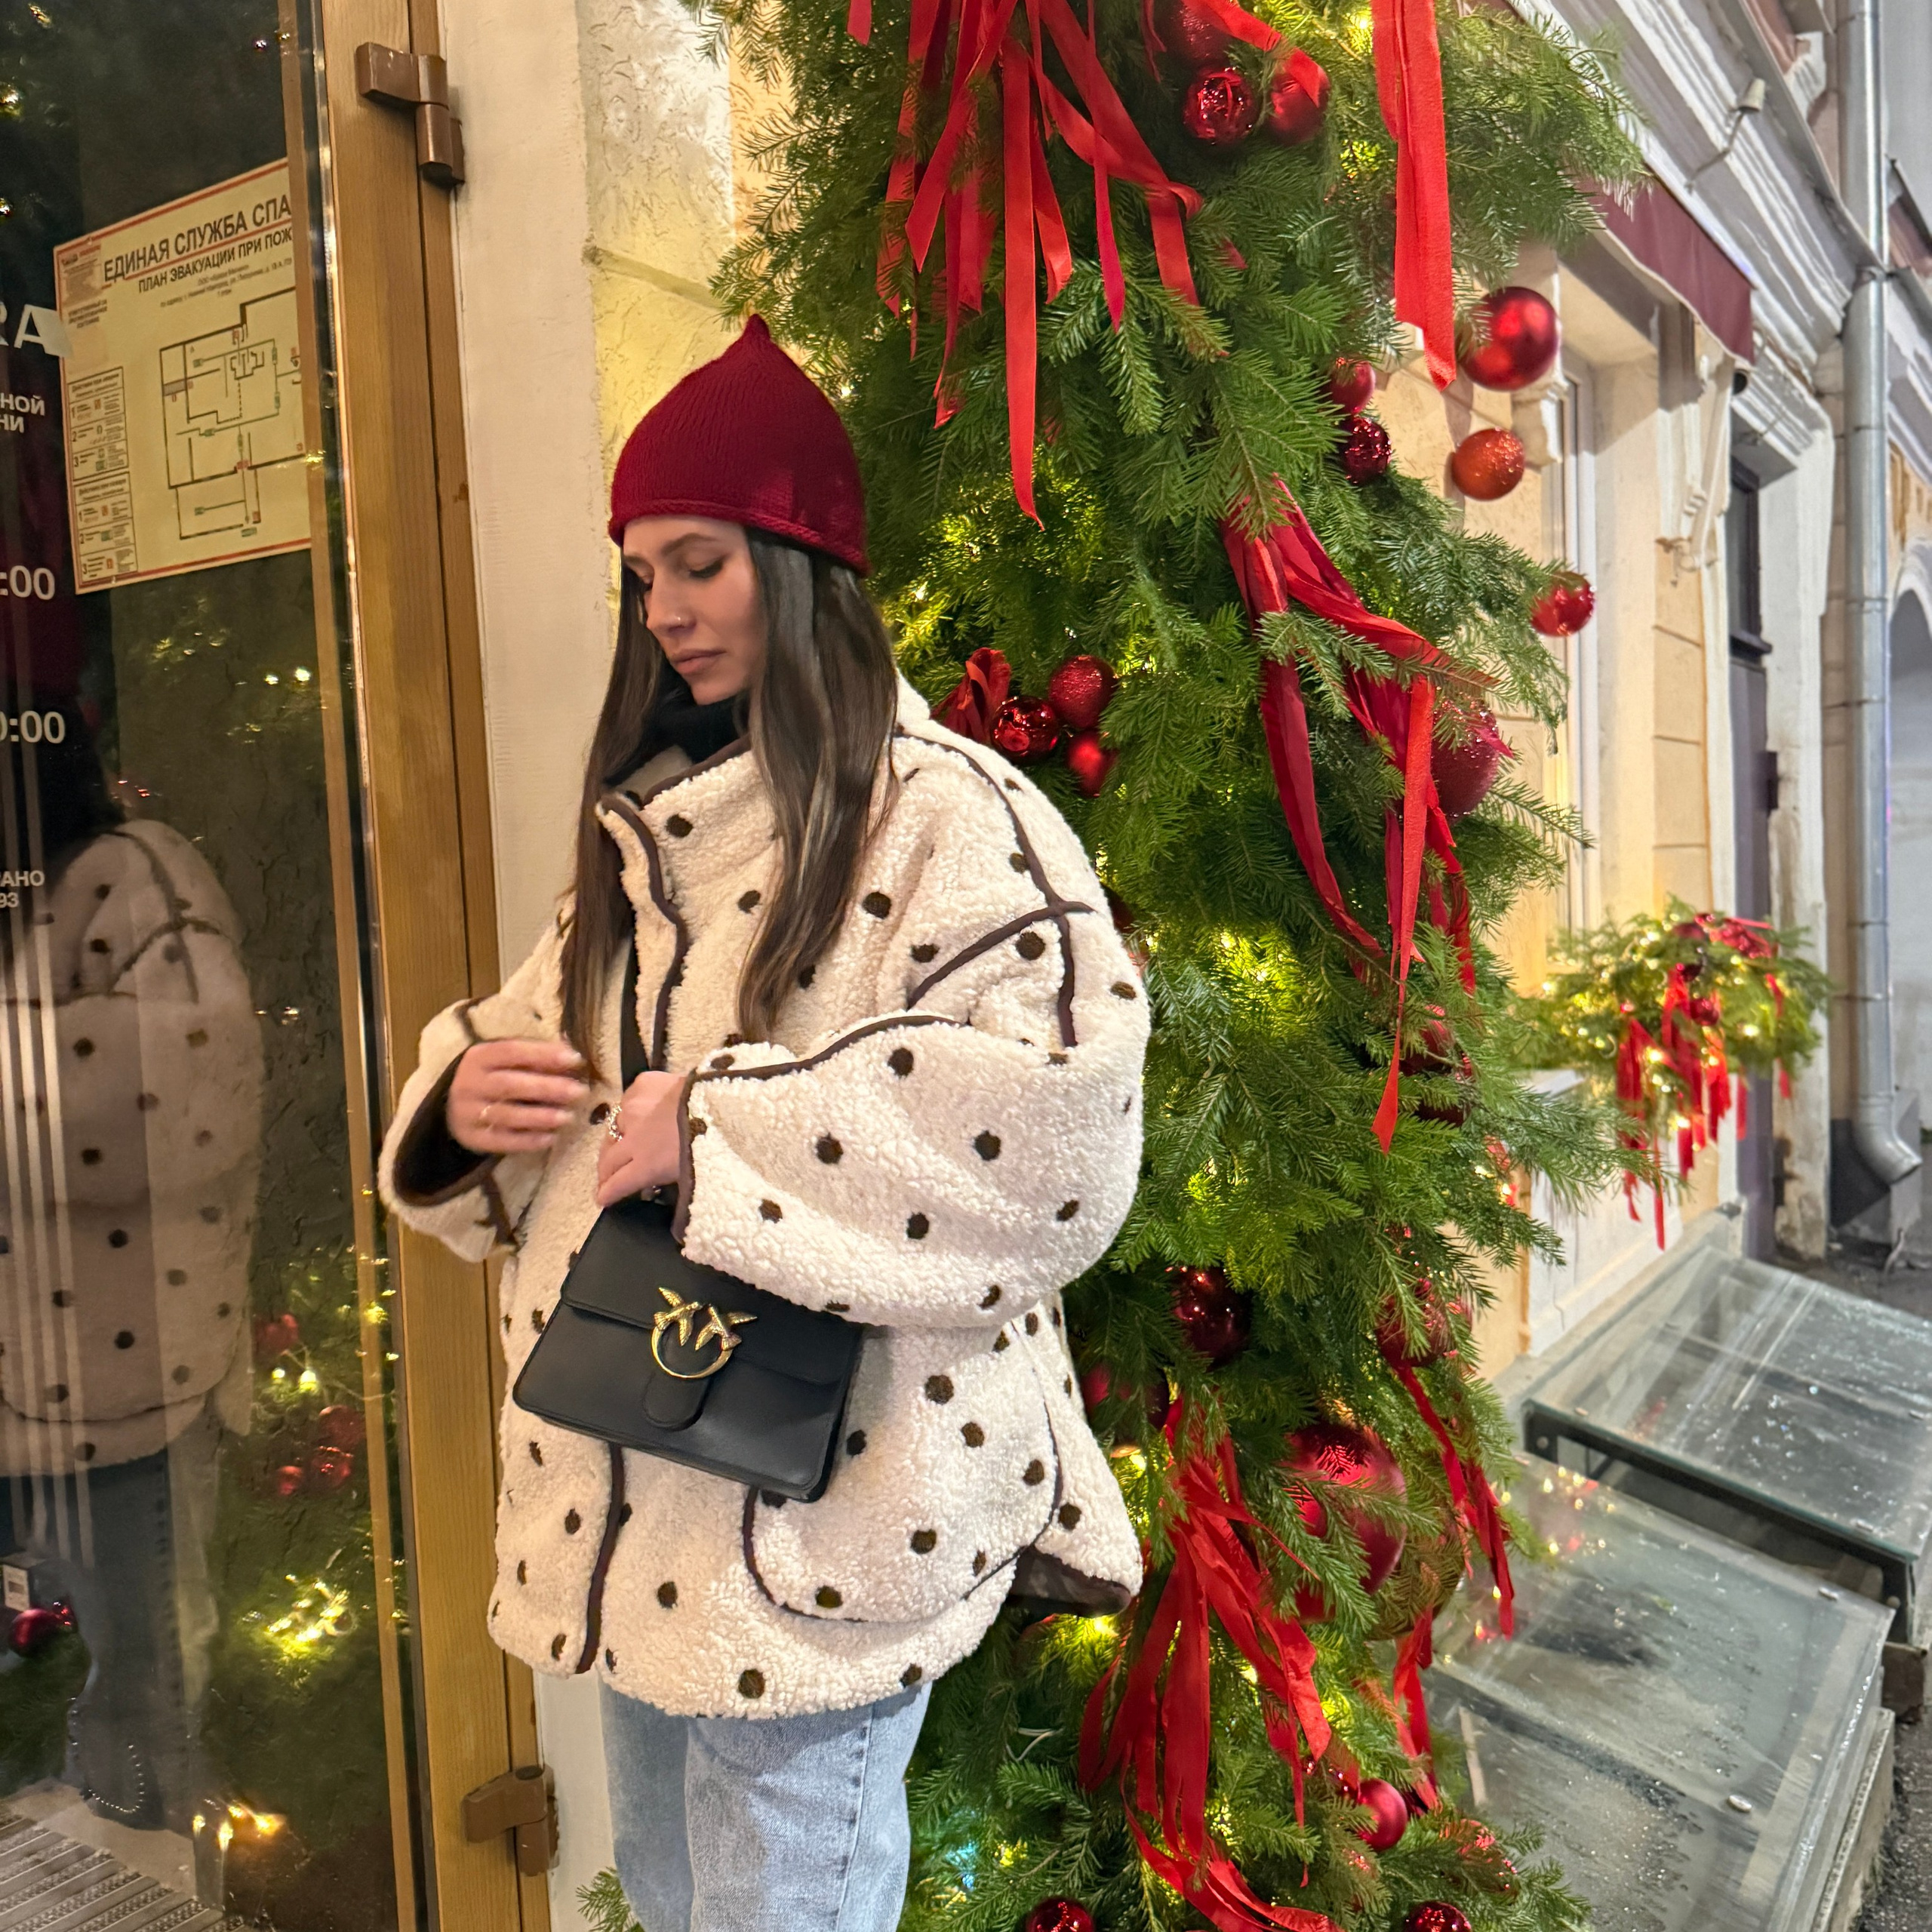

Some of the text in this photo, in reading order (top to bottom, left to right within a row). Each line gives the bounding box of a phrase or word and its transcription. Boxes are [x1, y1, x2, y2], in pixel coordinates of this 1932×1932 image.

[104, 239, 170, 283] ЕДИНАЯ
[174, 211, 248, 256] СЛУЖБА
[139, 272, 168, 294] ПЛАН
[171, 249, 235, 283] ЭВАКУАЦИИ
[238, 238, 262, 259] ПРИ
